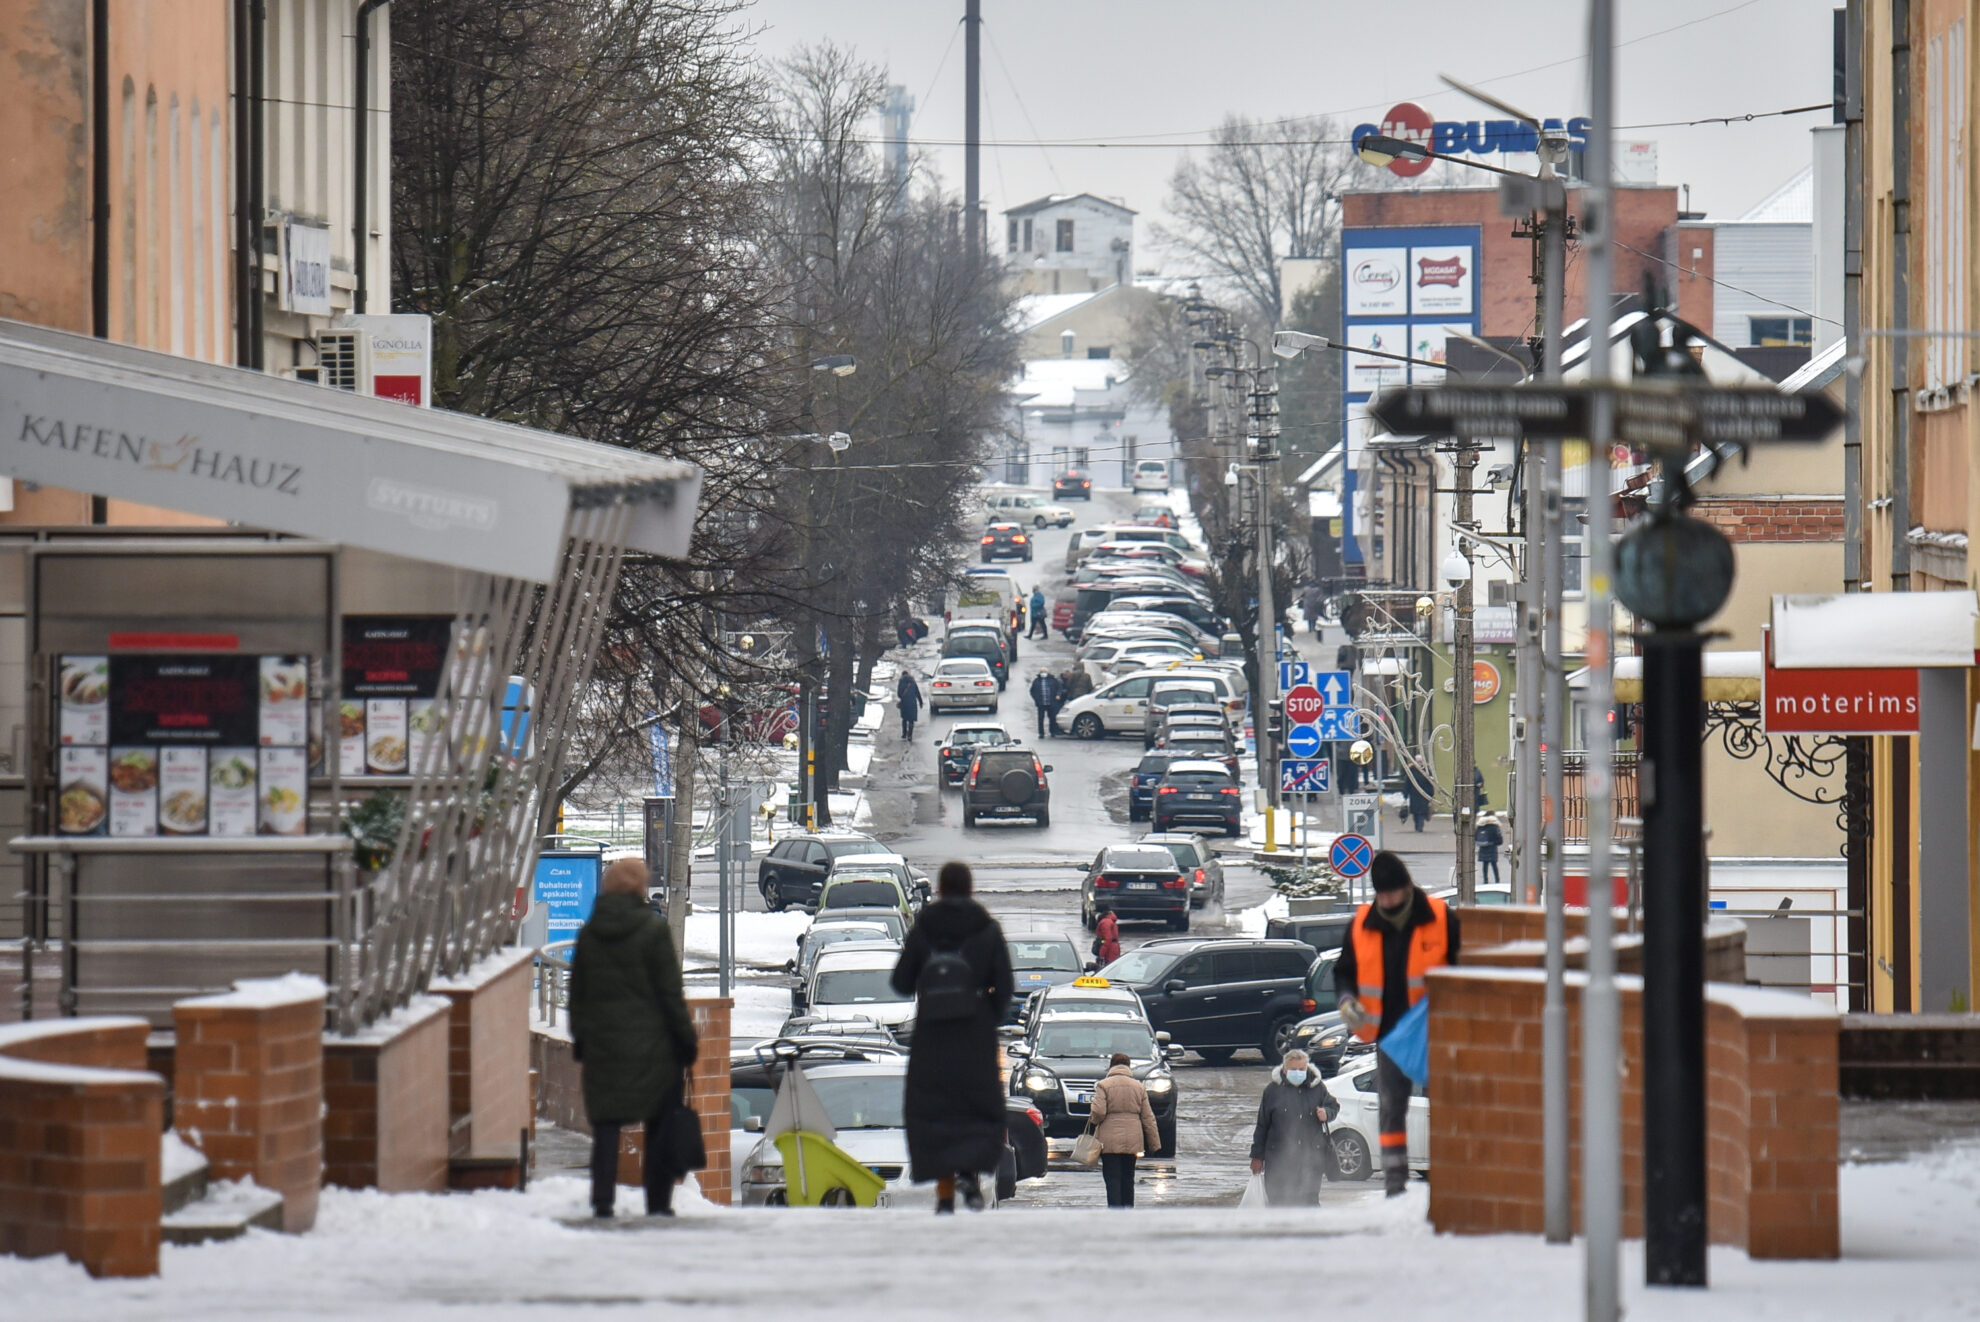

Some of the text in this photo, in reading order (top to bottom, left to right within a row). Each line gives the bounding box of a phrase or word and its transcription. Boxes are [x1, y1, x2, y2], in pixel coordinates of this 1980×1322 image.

[18, 414, 302, 496] KAFEN HAUZ
[1288, 697, 1321, 713] STOP
[1775, 691, 1917, 714] moterims
[538, 881, 583, 889] Buhalterinė
[542, 891, 579, 900] apskaitos
[546, 900, 579, 908] rograma
